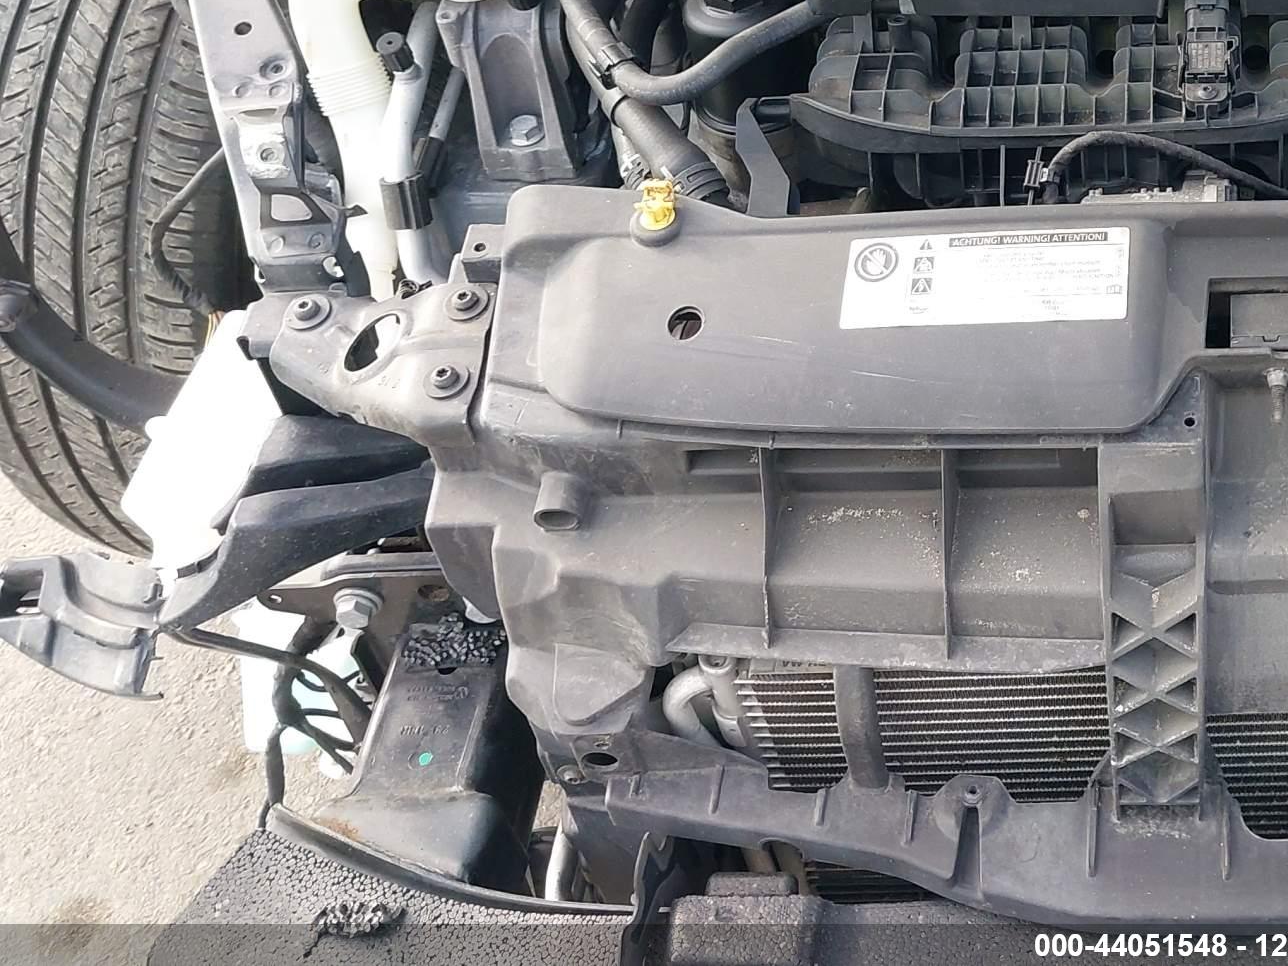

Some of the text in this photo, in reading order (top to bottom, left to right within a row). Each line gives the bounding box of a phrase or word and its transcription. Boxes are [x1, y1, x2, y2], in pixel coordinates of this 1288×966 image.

[952, 232, 1105, 247] ACHTUNG! WARNING! ATTENTION!
